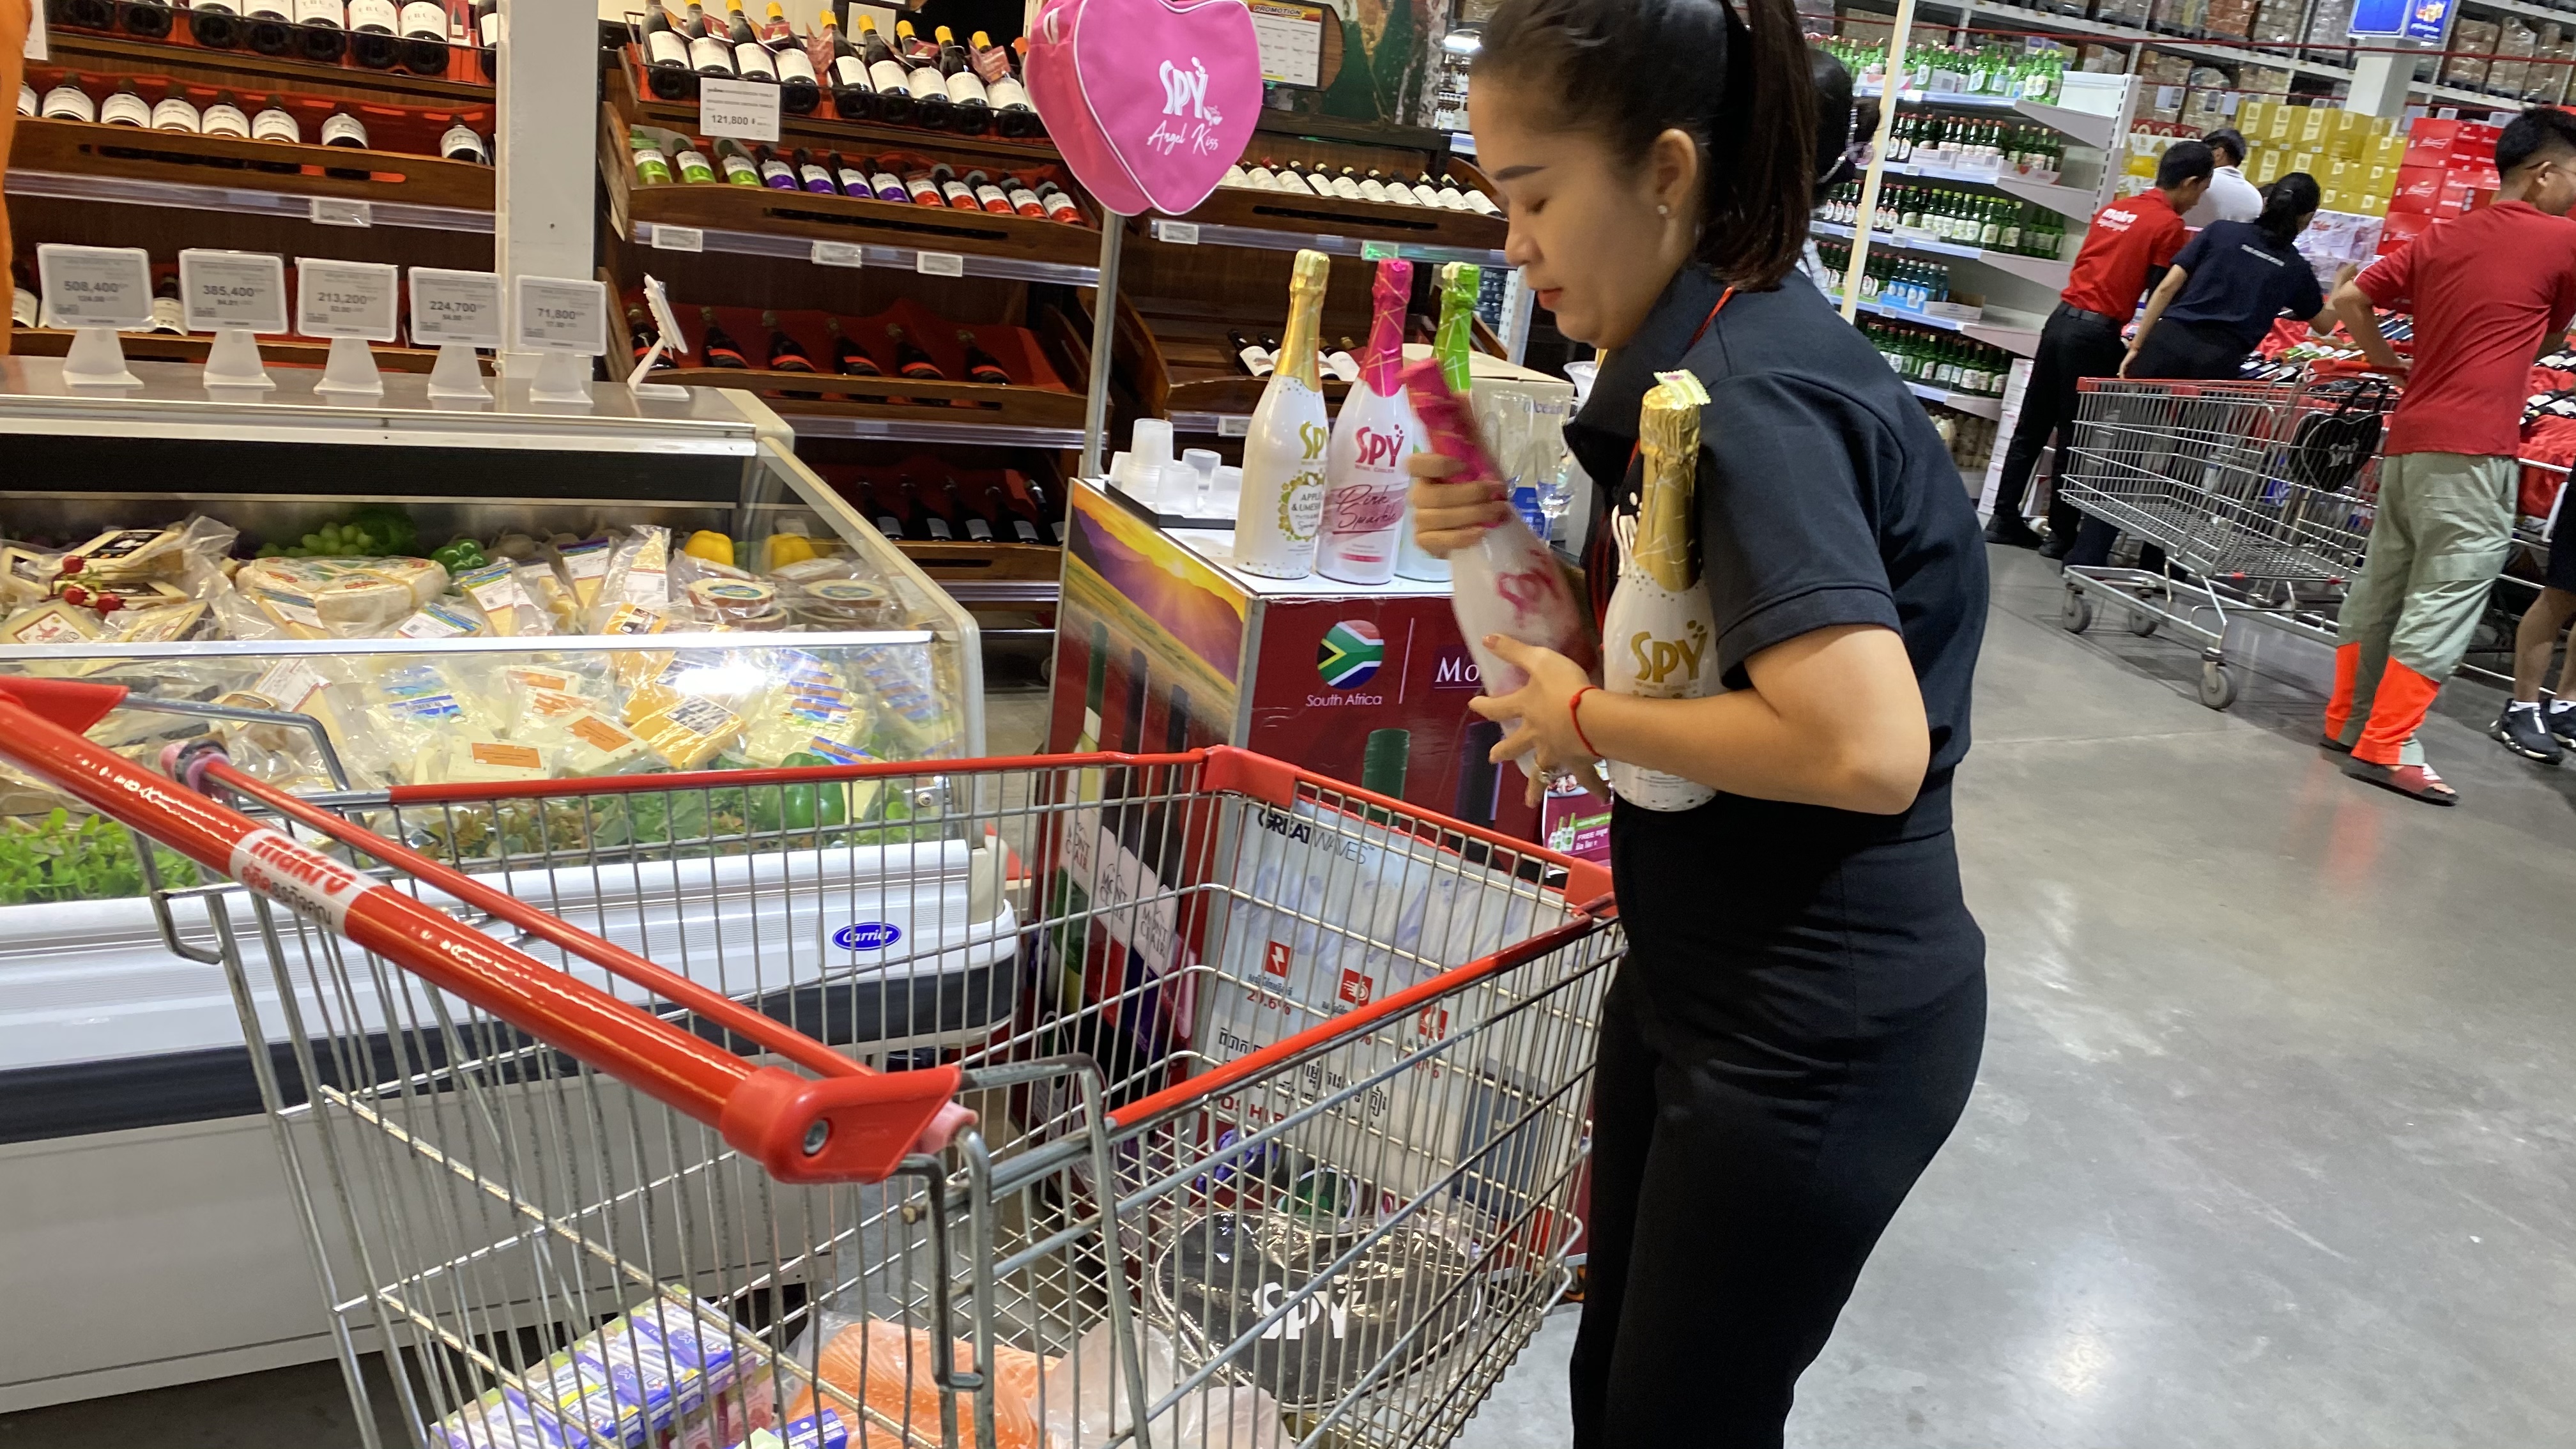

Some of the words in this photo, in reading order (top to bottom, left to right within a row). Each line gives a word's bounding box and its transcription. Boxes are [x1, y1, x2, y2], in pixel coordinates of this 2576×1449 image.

[1254, 5, 1301, 15] PROMOTION
[1159, 57, 1209, 119] SPY
[711, 114, 749, 125] 121,800
[1147, 119, 1188, 156] Angel
[1191, 123, 1220, 157] Kiss
[64, 280, 119, 293] 508,400
[203, 284, 255, 298] 385,400
[317, 292, 368, 305] 213,200
[429, 300, 477, 314] 224,700
[537, 307, 576, 320] 71,800
[1355, 424, 1404, 467] SPY
[1337, 484, 1389, 511] Pink
[1630, 621, 1708, 683] SPY
[1305, 694, 1342, 707] South
[1344, 693, 1383, 706] Africa
[250, 836, 356, 897] makro
[1252, 1276, 1363, 1340] SPY
